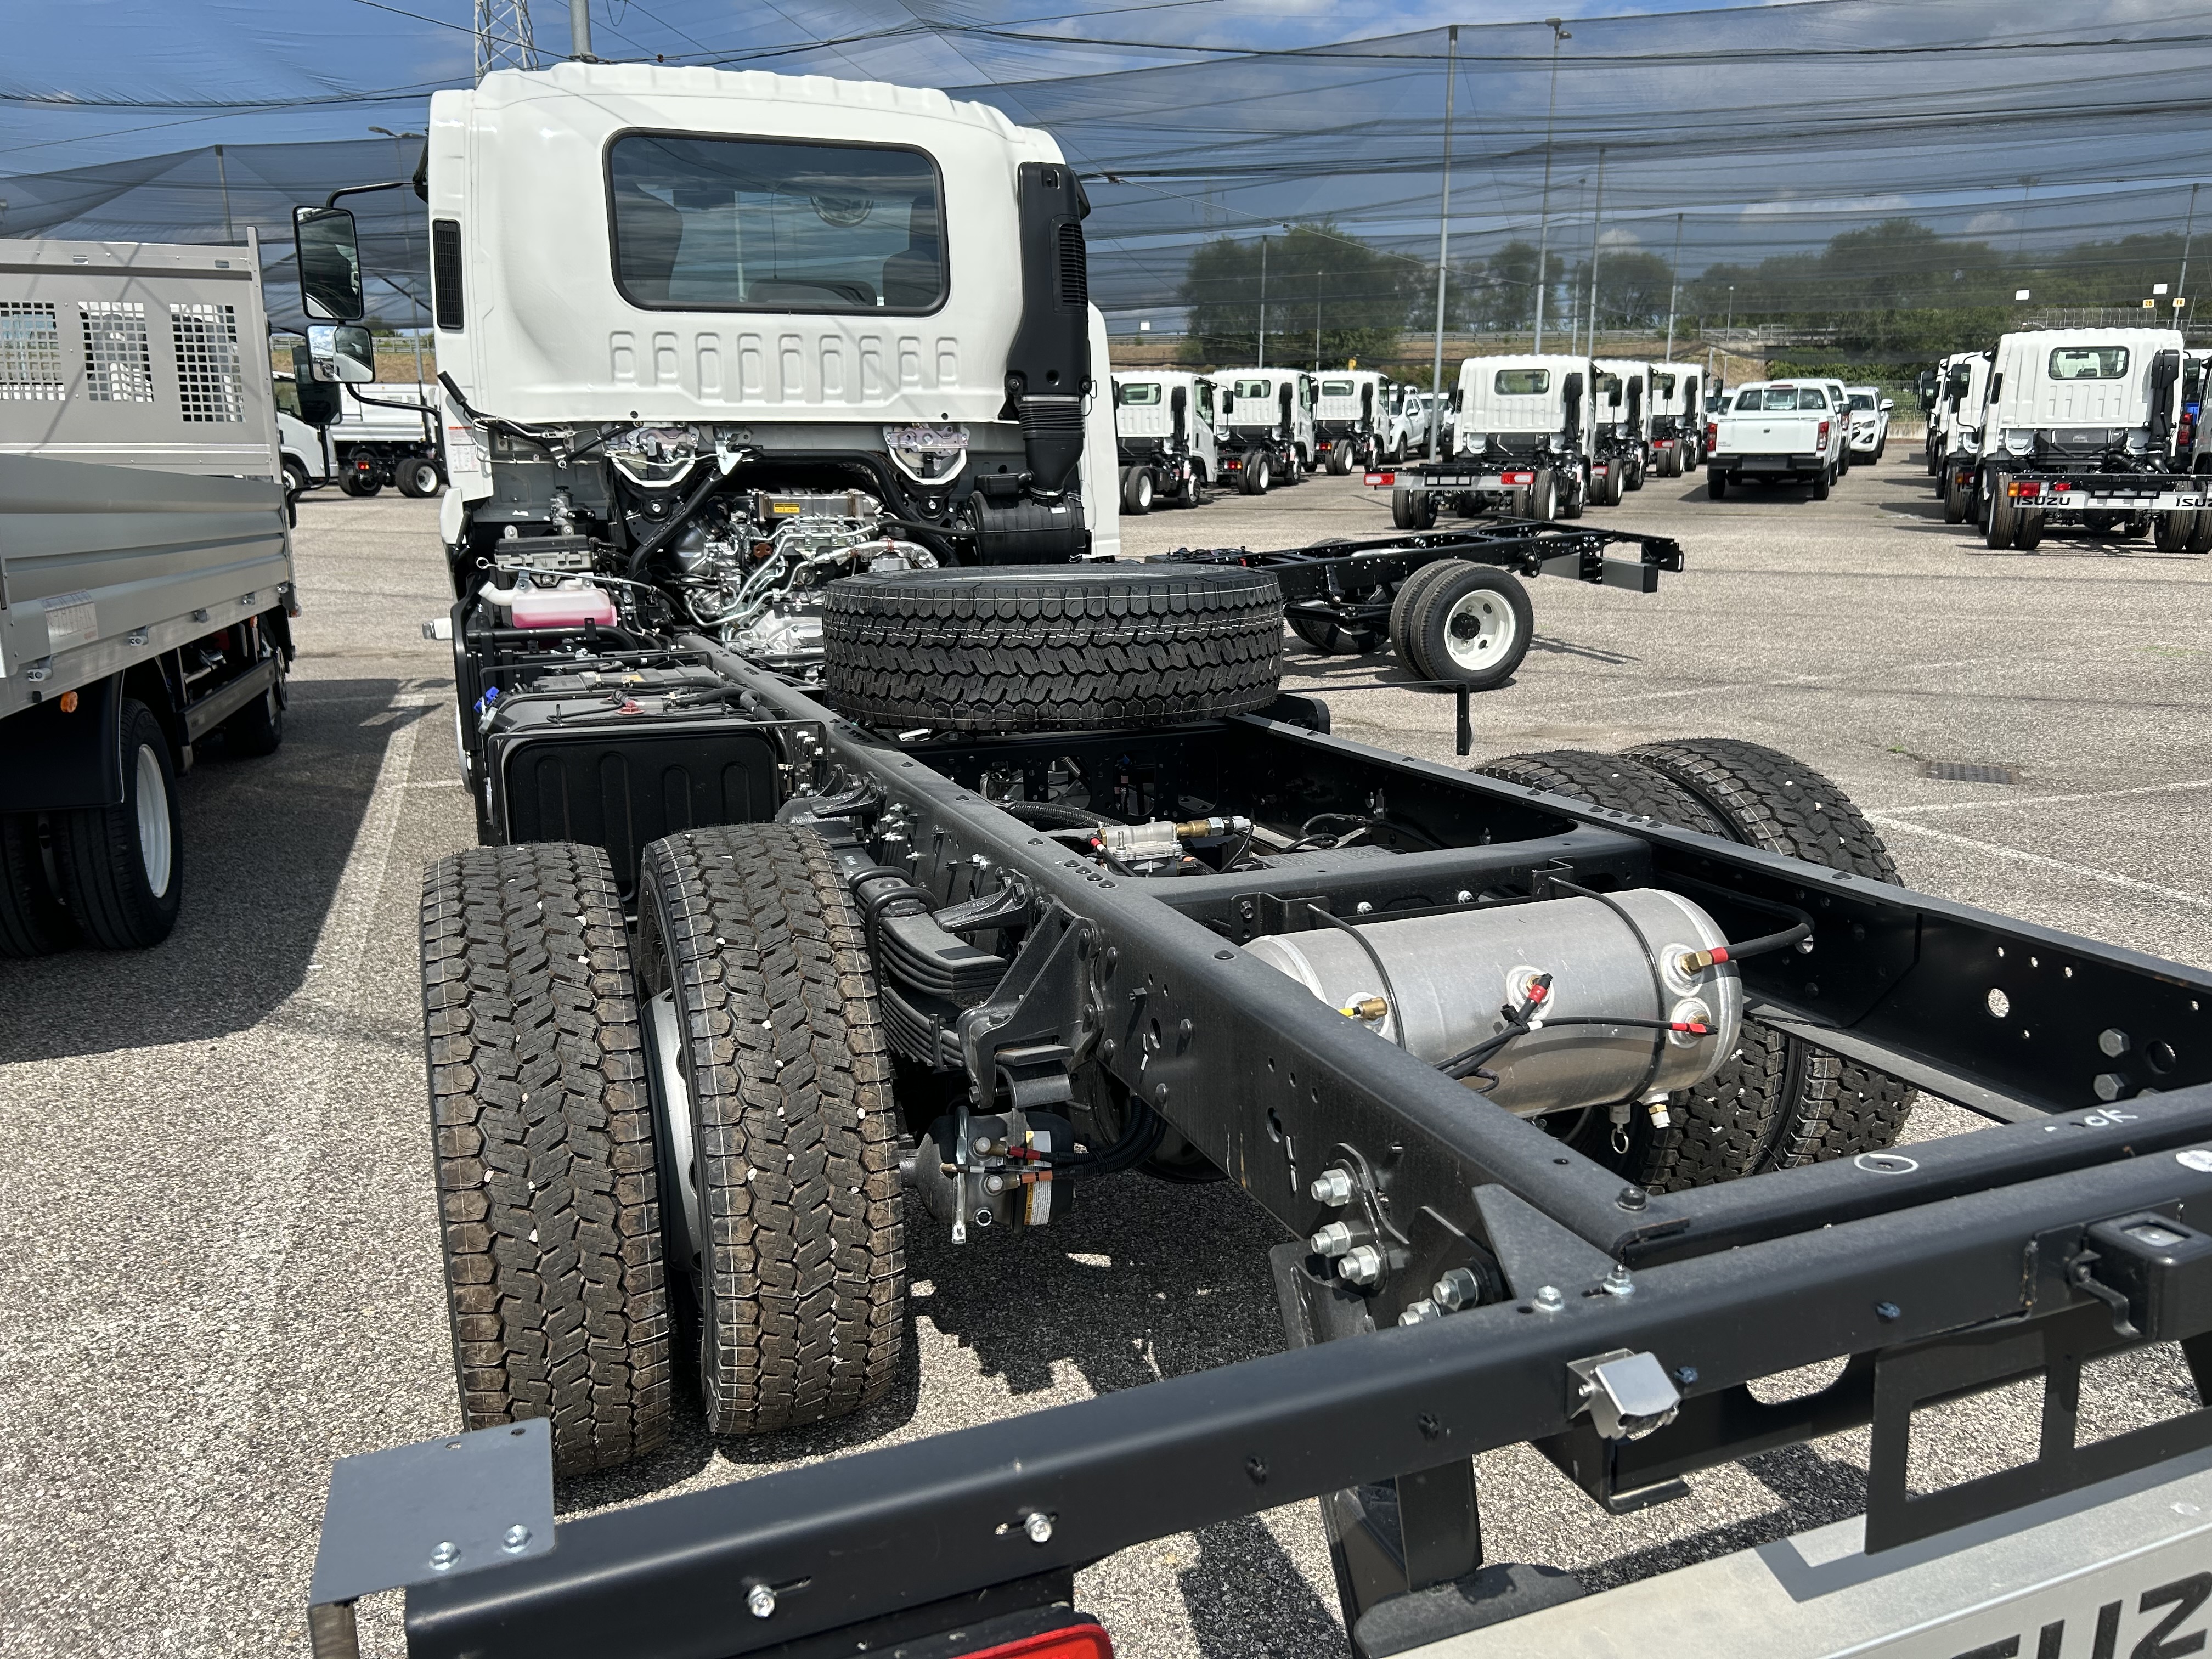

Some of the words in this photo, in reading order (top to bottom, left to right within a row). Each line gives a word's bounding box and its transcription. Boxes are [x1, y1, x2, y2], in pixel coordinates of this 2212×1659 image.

[2016, 496, 2070, 505] ISUZU
[2084, 1109, 2138, 1126] OK
[1950, 1570, 2212, 1659] UZ
